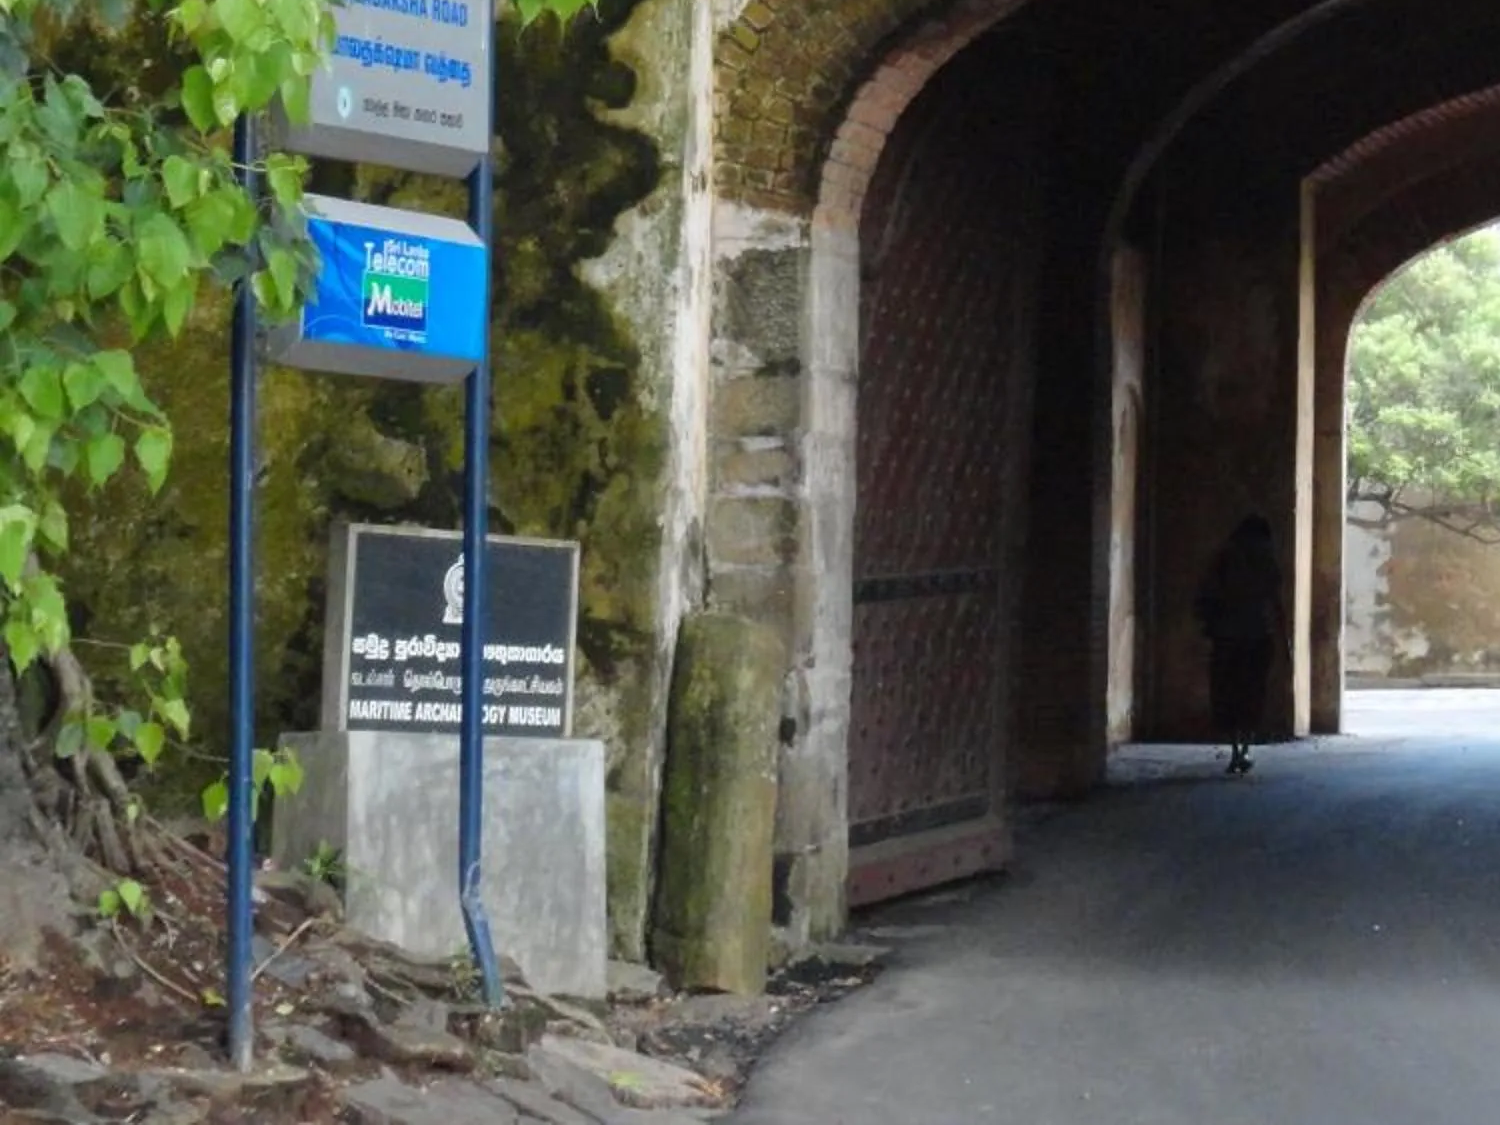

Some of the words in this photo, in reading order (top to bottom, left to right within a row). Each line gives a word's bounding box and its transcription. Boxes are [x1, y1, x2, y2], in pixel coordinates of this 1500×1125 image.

[364, 241, 430, 279] Telecom
[367, 283, 424, 319] Mobitel
[350, 699, 413, 721] MARITIME
[508, 705, 561, 726] MUSEUM
